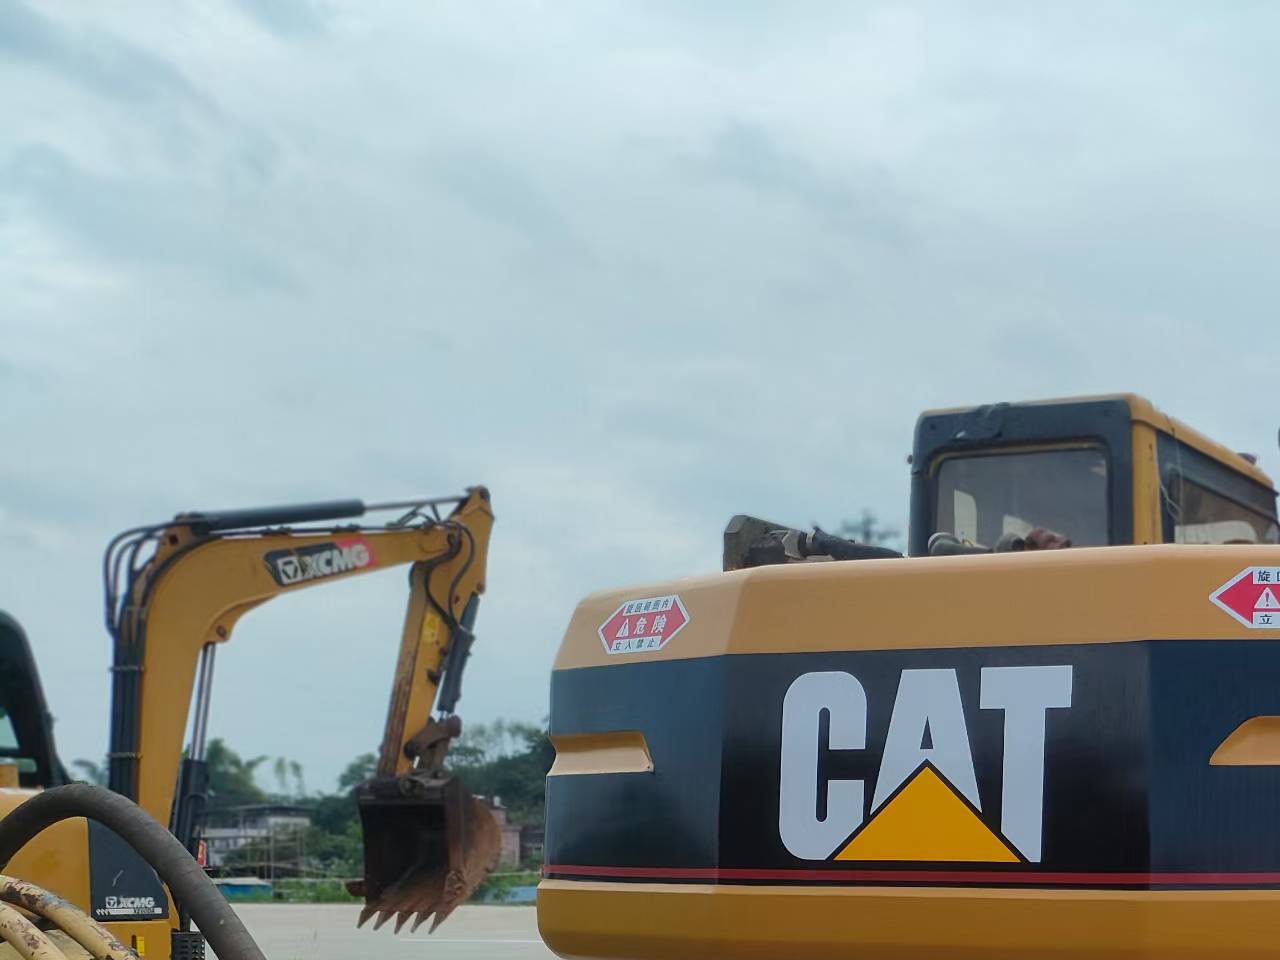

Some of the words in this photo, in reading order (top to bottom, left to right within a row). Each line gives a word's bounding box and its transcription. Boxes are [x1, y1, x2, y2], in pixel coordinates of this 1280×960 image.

[301, 543, 369, 579] XCMG
[778, 665, 1073, 863] CAT
[118, 896, 155, 908] XCMG
